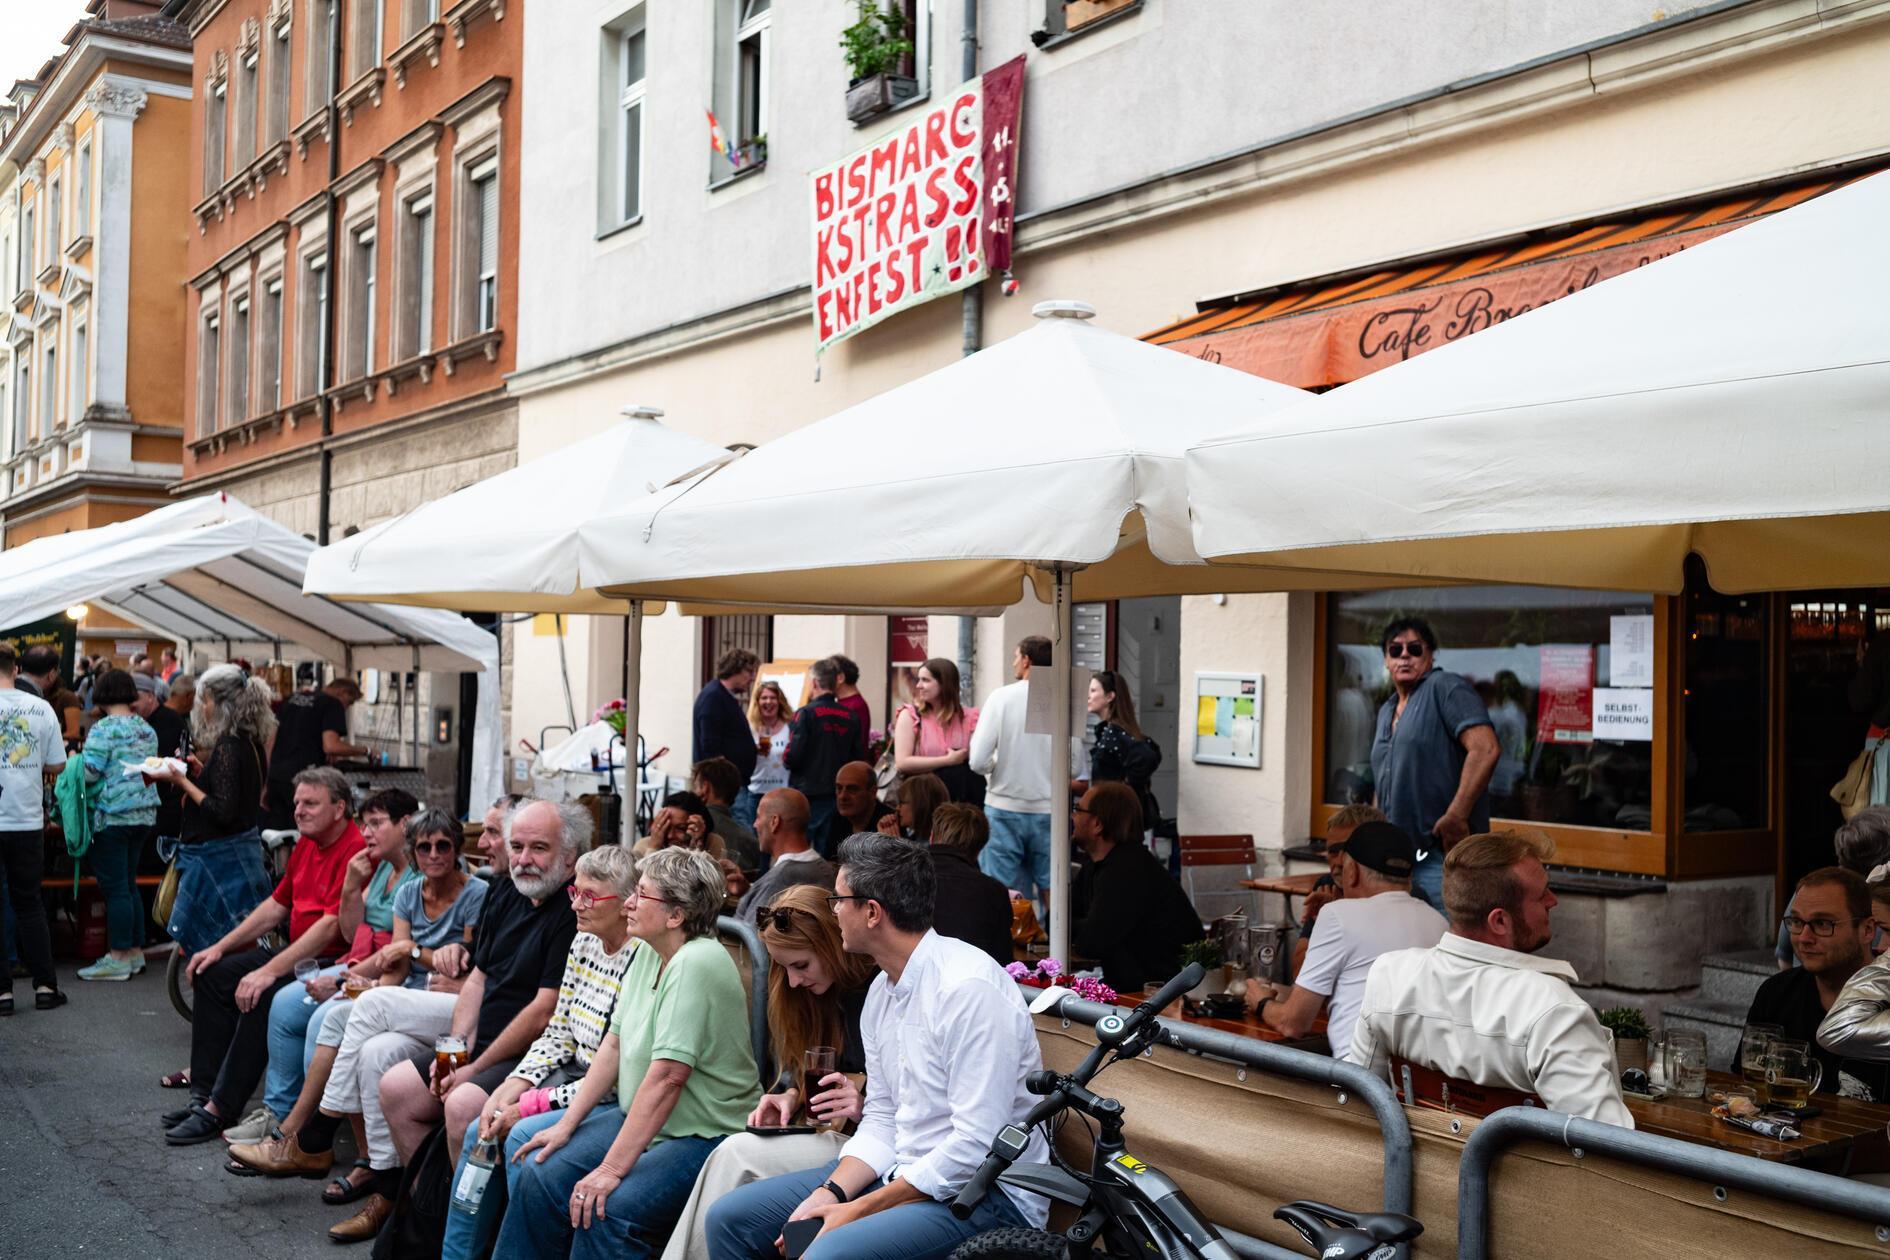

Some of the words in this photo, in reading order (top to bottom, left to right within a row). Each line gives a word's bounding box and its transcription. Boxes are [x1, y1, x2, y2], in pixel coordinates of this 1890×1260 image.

[815, 92, 977, 222] BISMARC
[816, 155, 978, 289] KSTRASS
[816, 235, 929, 342] ENFEST
[1597, 714, 1649, 724] BEDIENUNG
